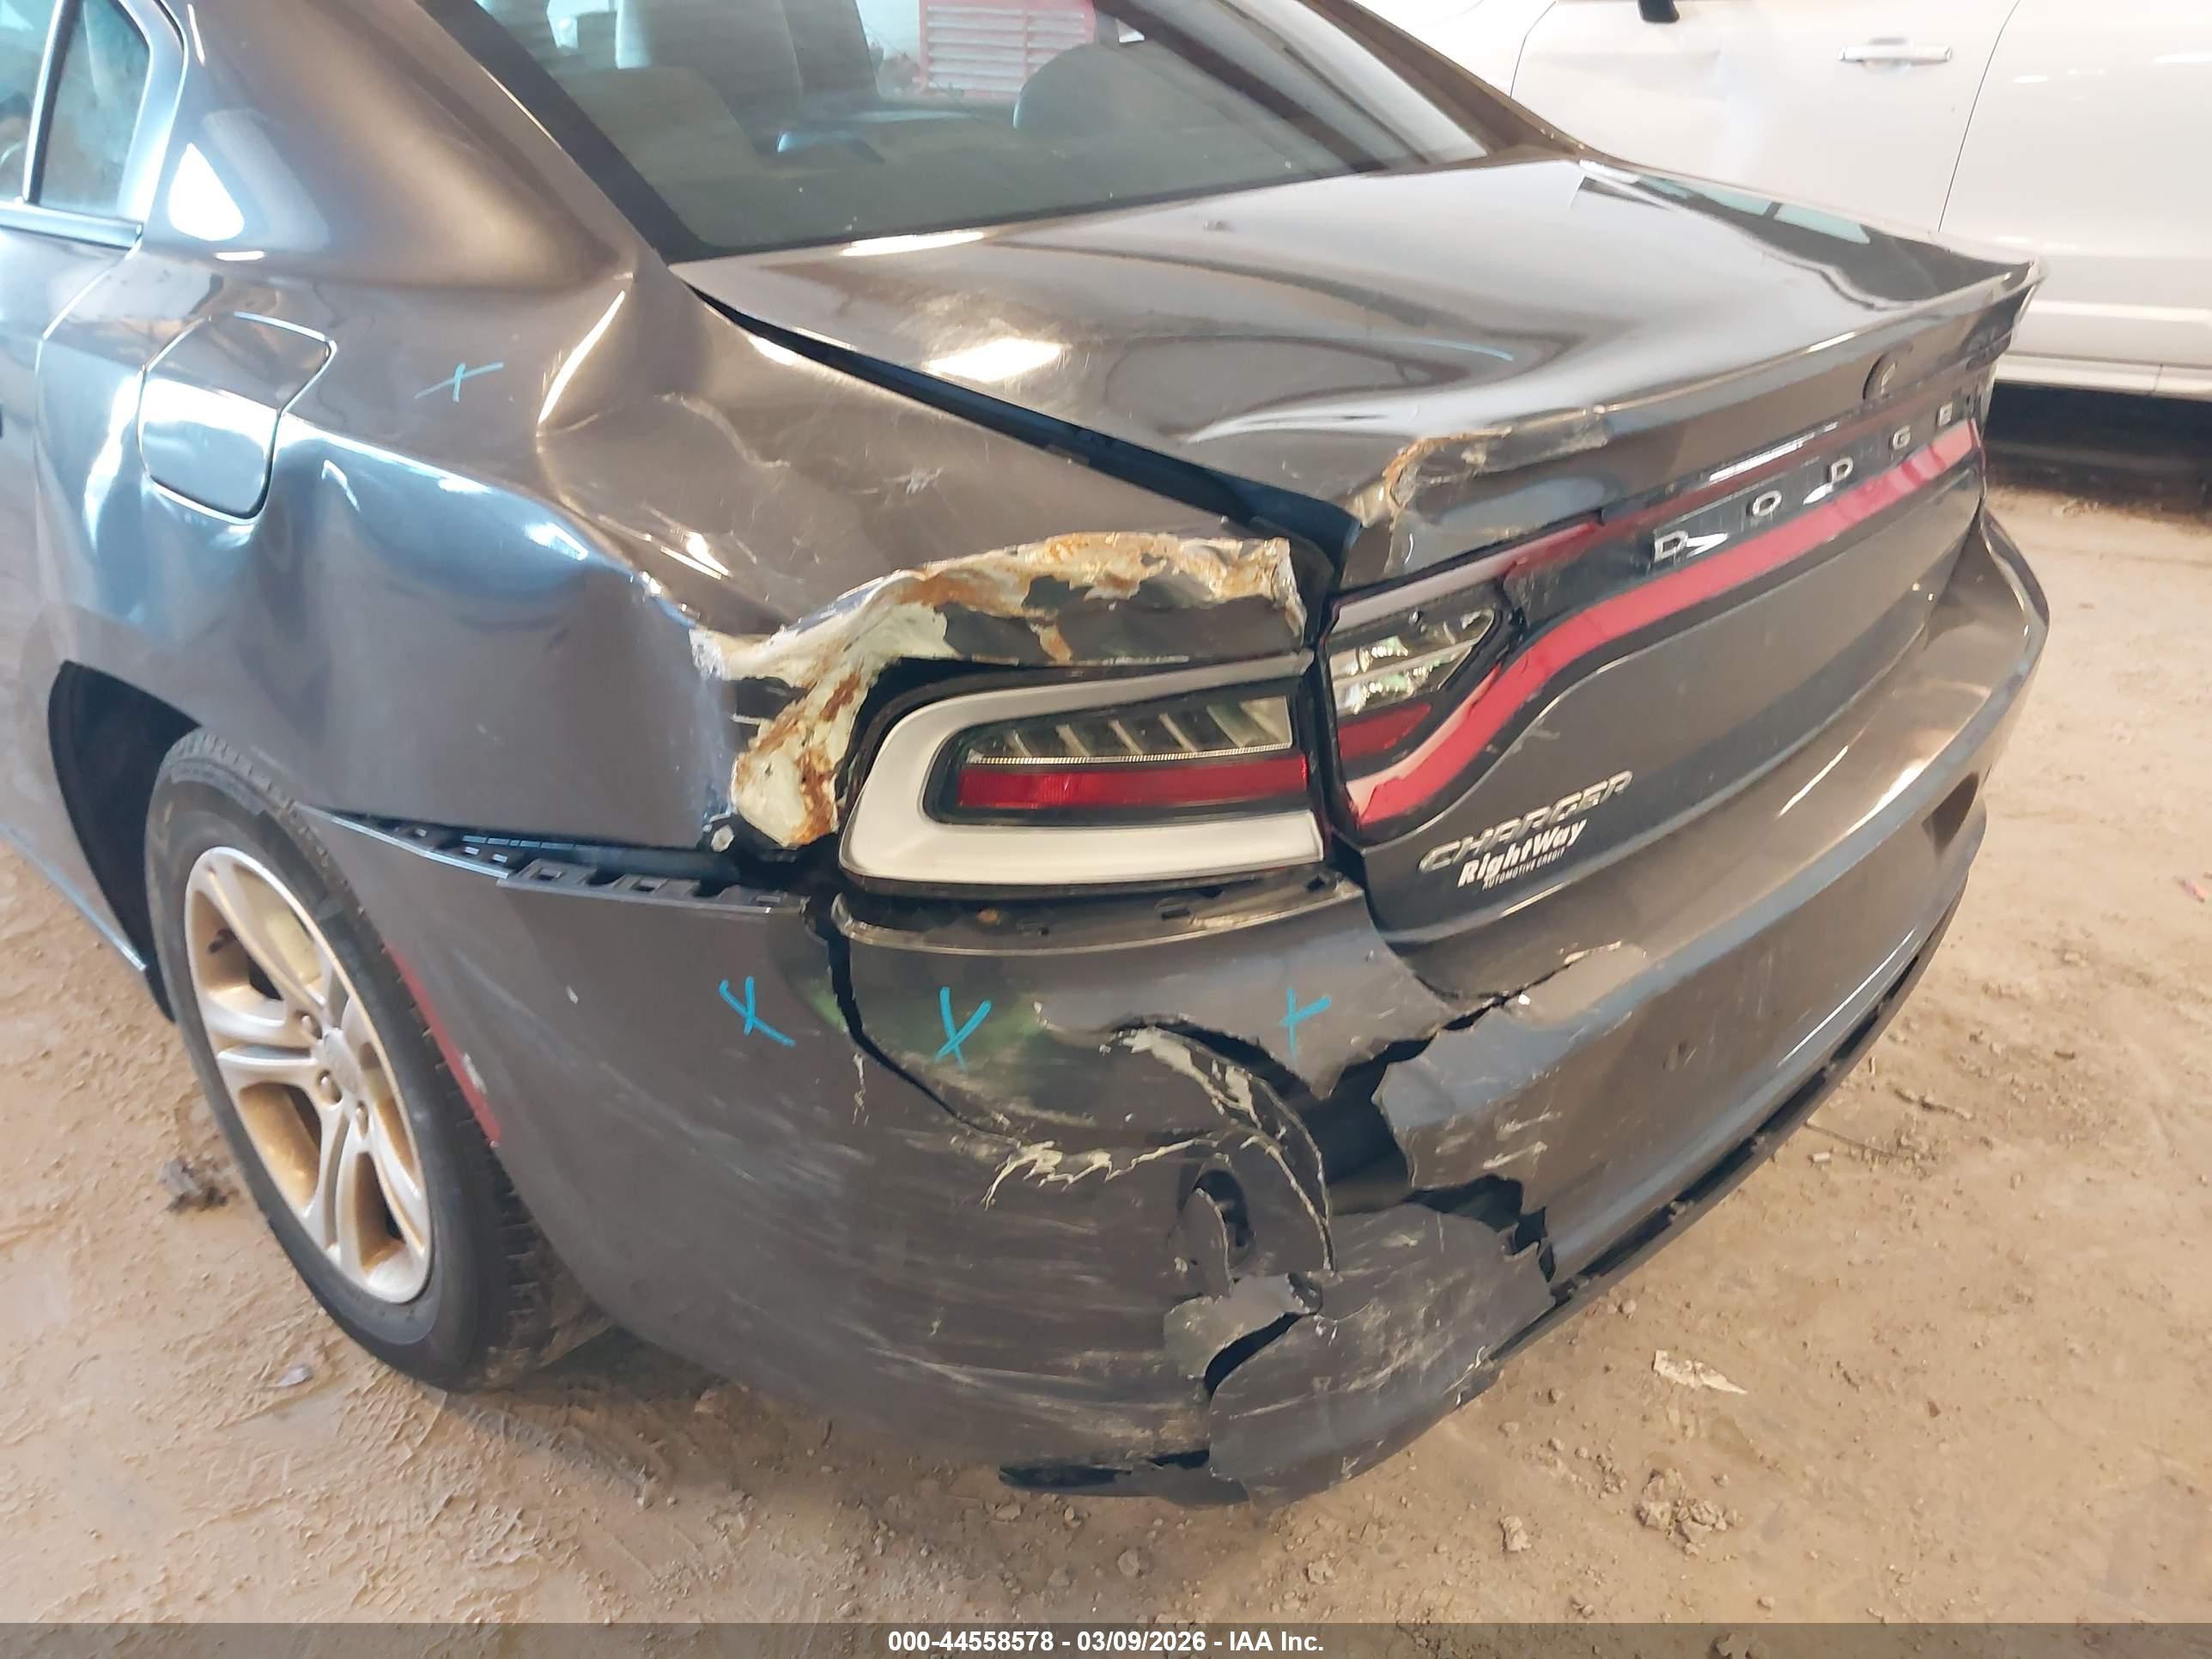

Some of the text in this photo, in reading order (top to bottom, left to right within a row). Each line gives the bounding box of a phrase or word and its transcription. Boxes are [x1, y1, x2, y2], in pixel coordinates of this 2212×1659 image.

[1654, 401, 1954, 562] DODGE
[1419, 770, 1633, 873] CHARGER
[1482, 846, 1566, 890] AUTOMOTIVE CREDIT
